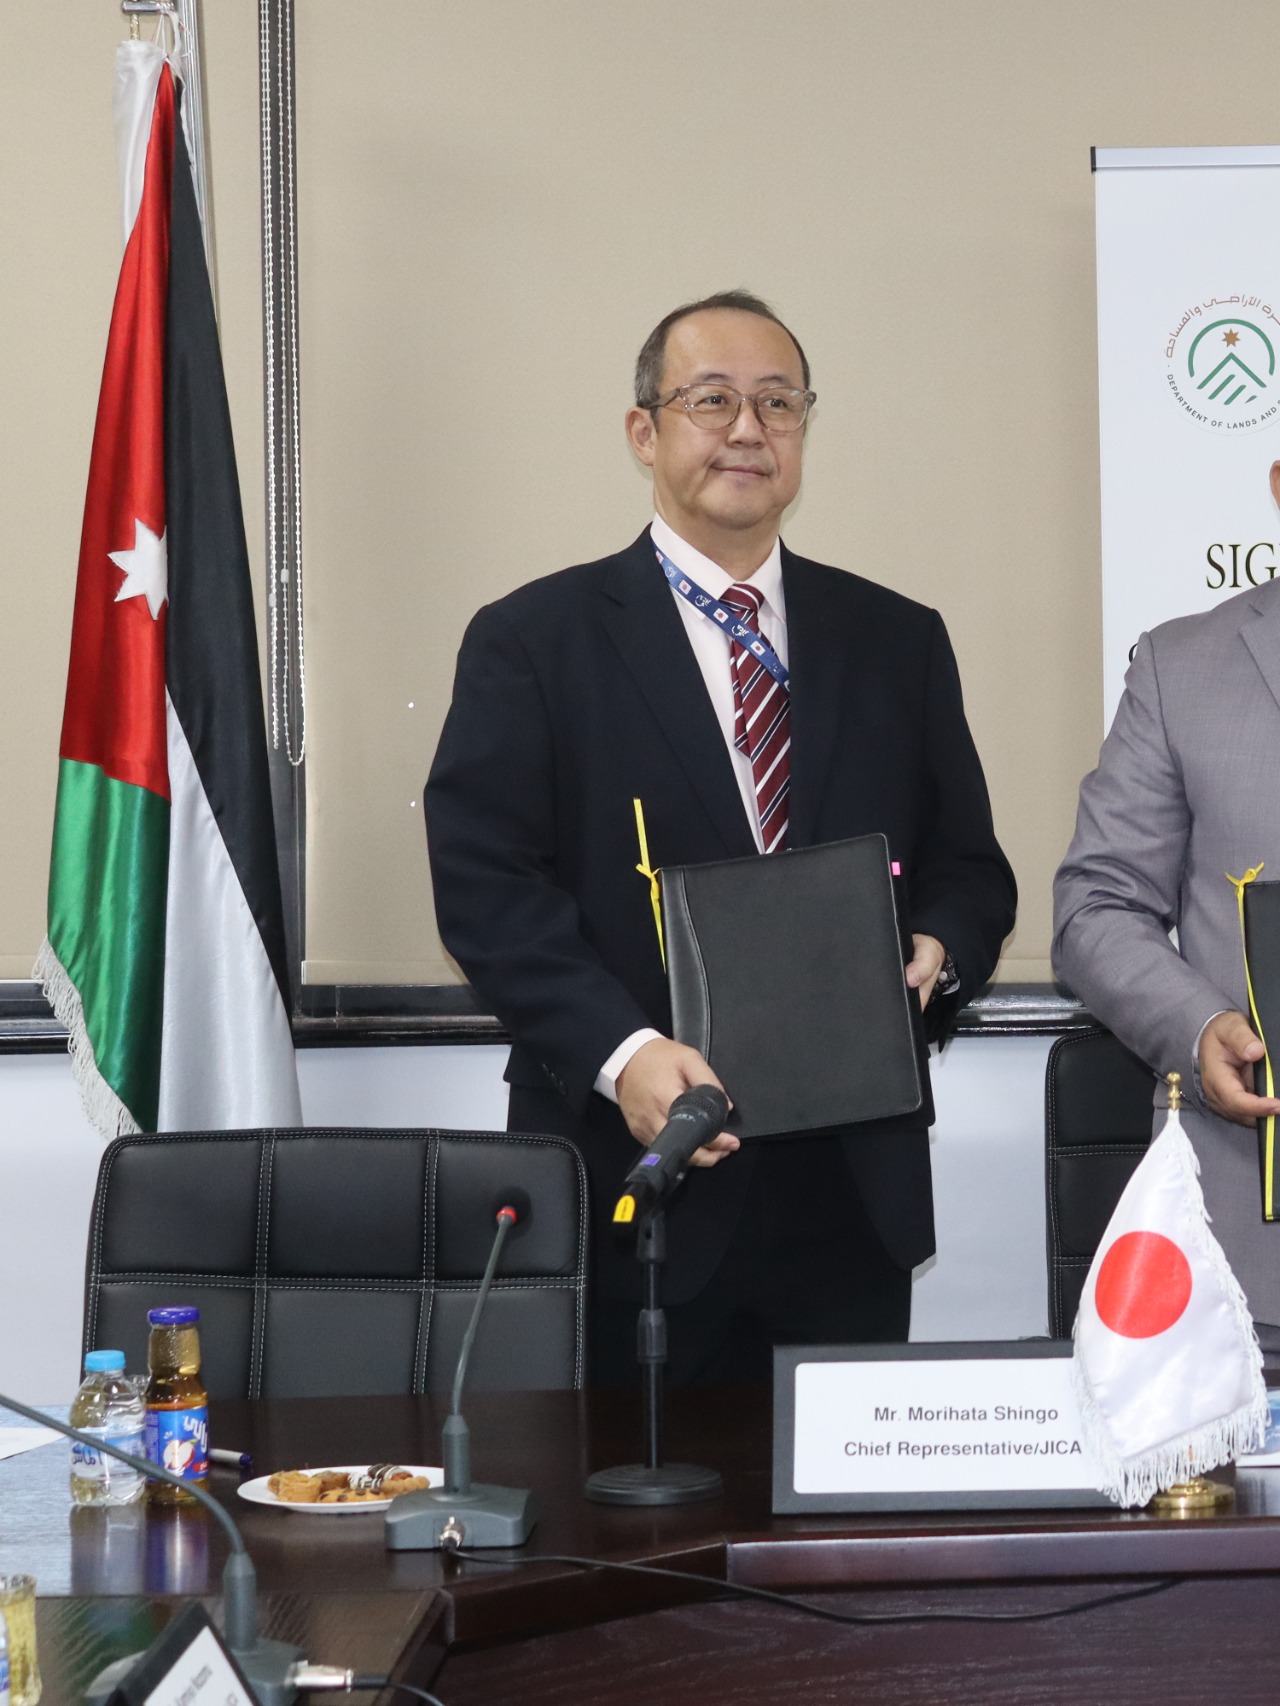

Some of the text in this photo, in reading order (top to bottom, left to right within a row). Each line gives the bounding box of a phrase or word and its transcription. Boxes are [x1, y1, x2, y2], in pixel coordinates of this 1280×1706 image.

[1167, 374, 1208, 423] DEPARTMENT
[1211, 420, 1223, 428] OF
[1227, 418, 1257, 429] LANDS
[1260, 406, 1278, 421] AND
[874, 1405, 1059, 1424] Mr. Morihata Shingo
[844, 1440, 1083, 1459] Chief Representative/JICA
